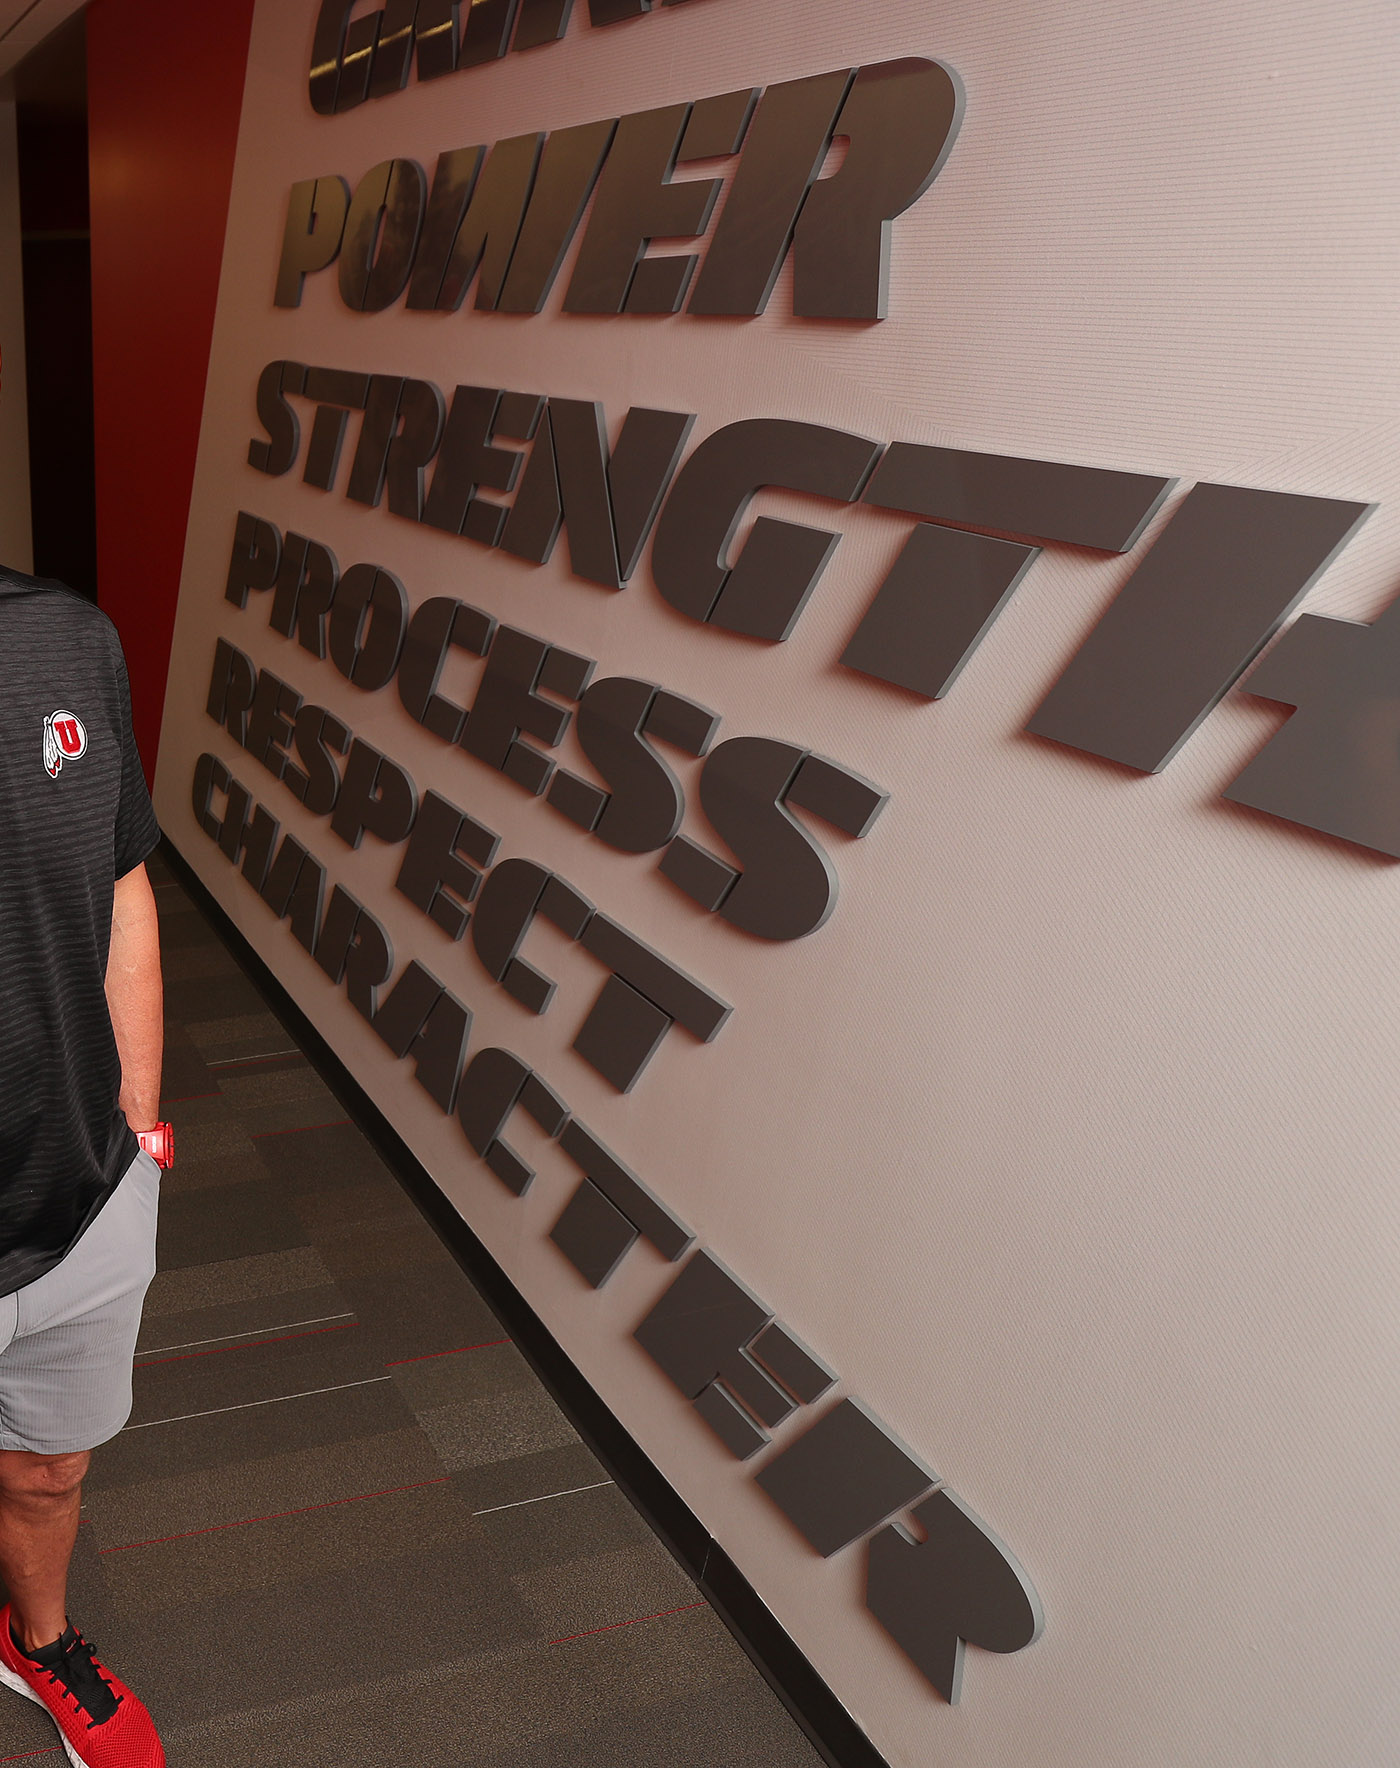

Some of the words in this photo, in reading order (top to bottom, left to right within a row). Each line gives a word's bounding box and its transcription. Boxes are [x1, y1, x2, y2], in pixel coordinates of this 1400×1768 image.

[273, 56, 966, 320] POWER
[54, 719, 82, 754] U
[206, 636, 734, 1094] RESPECT
[224, 511, 890, 942] PROCESS
[192, 752, 1044, 1706] CHARACTER
